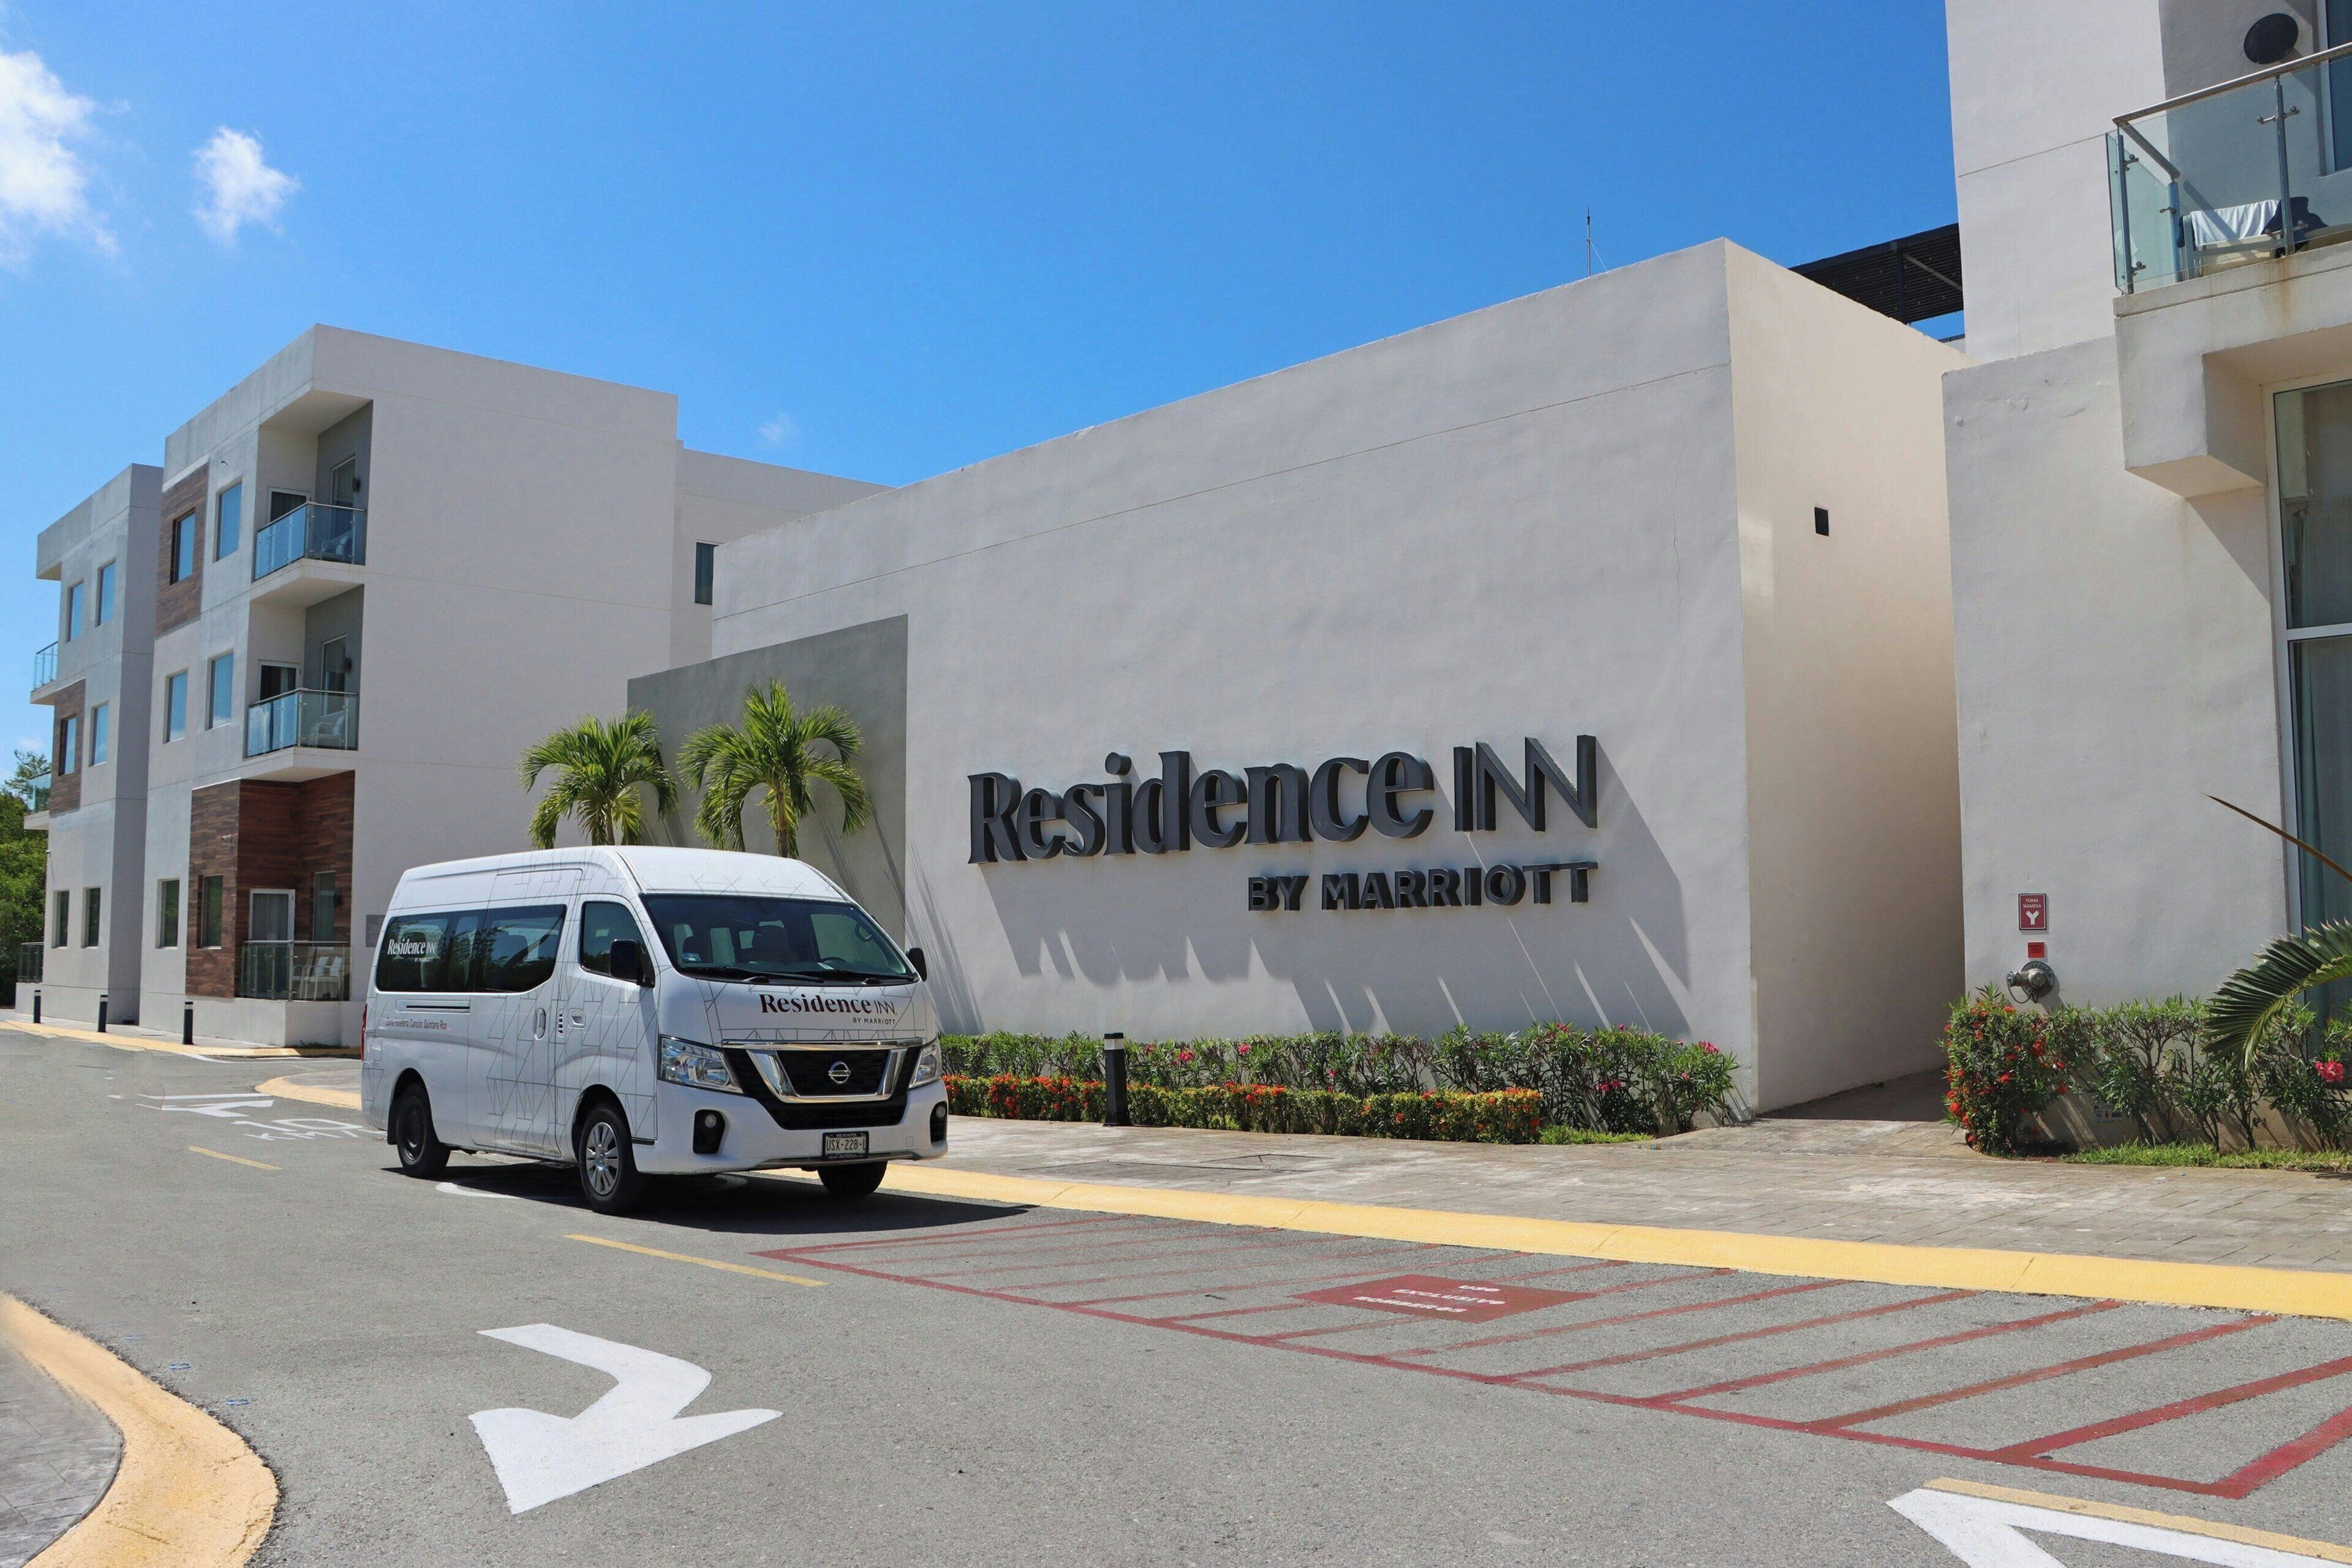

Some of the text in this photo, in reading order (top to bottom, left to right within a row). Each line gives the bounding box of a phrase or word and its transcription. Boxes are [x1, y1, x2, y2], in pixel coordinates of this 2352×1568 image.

[967, 734, 1597, 864] Residence INN
[1248, 861, 1599, 911] BY MARRIOTT
[387, 938, 437, 955] Residence INN
[759, 993, 872, 1014] Residence
[1352, 1296, 1468, 1313] BOMBEROS
[1392, 1289, 1506, 1305] EXCLUSIVO
